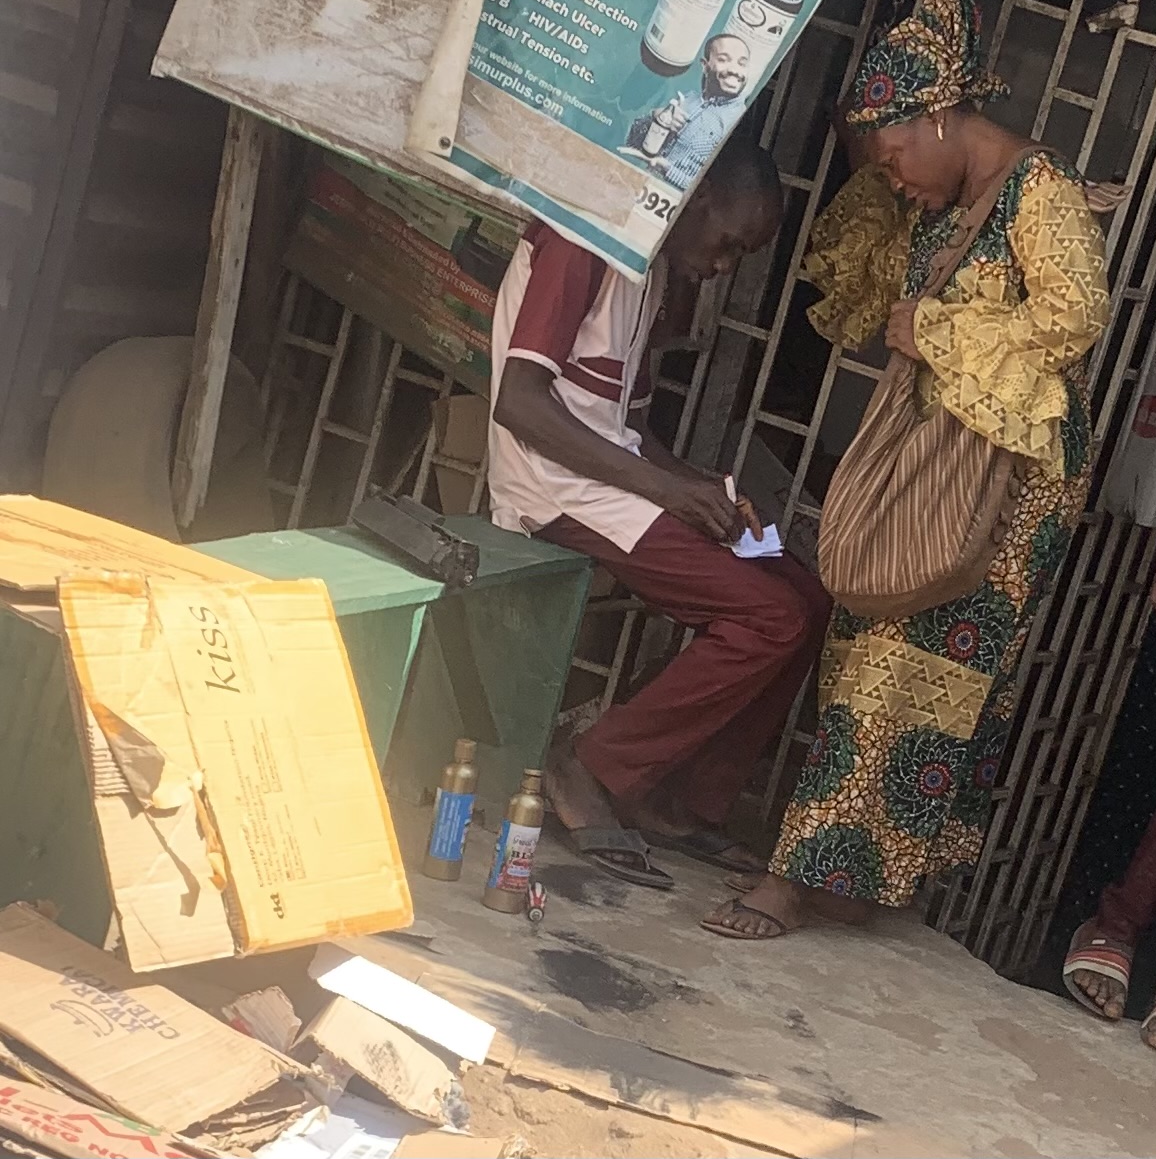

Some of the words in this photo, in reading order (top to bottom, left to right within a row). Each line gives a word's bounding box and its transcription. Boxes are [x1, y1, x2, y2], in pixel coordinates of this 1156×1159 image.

[480, 11, 519, 40] strual
[520, 30, 571, 69] Tension
[569, 63, 596, 86] etc.
[571, 10, 608, 39] Ulcer
[489, 50, 524, 75] website
[524, 69, 539, 84] for
[539, 80, 562, 97] more
[562, 90, 613, 126] information
[190, 605, 242, 695] kiss
